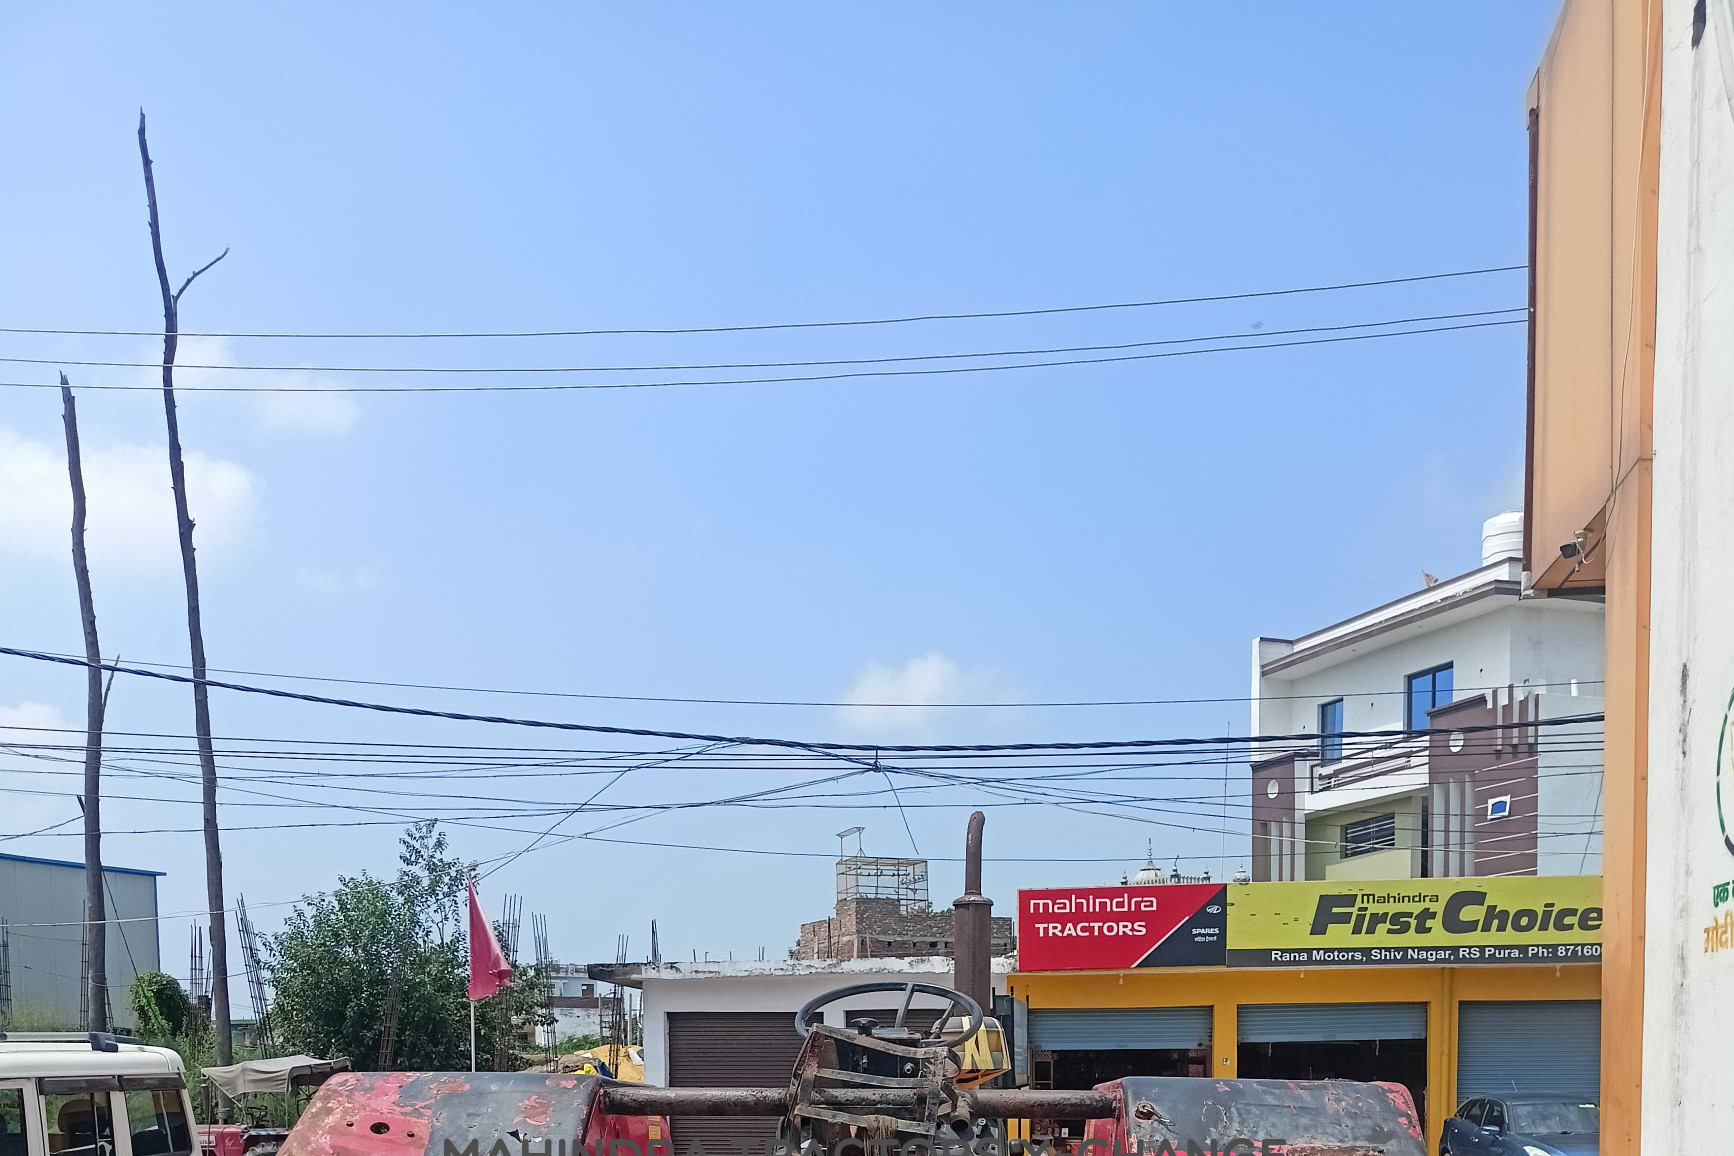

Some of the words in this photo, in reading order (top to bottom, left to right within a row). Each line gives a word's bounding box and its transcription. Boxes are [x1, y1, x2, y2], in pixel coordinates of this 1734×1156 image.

[1029, 893, 1157, 913] mahindra
[1361, 893, 1439, 905] Mahindra
[1309, 893, 1438, 936] First
[1441, 890, 1603, 934] Choice
[1035, 921, 1147, 937] TRACTORS
[1191, 927, 1220, 935] SPARES
[1271, 950, 1308, 961] Rana
[1312, 949, 1366, 962] Motors,
[1370, 948, 1403, 960] Shiv
[1407, 948, 1454, 962] Nagar,
[1459, 947, 1480, 959] RS
[1485, 946, 1523, 958] Pura.
[1528, 945, 1553, 957] Ph:
